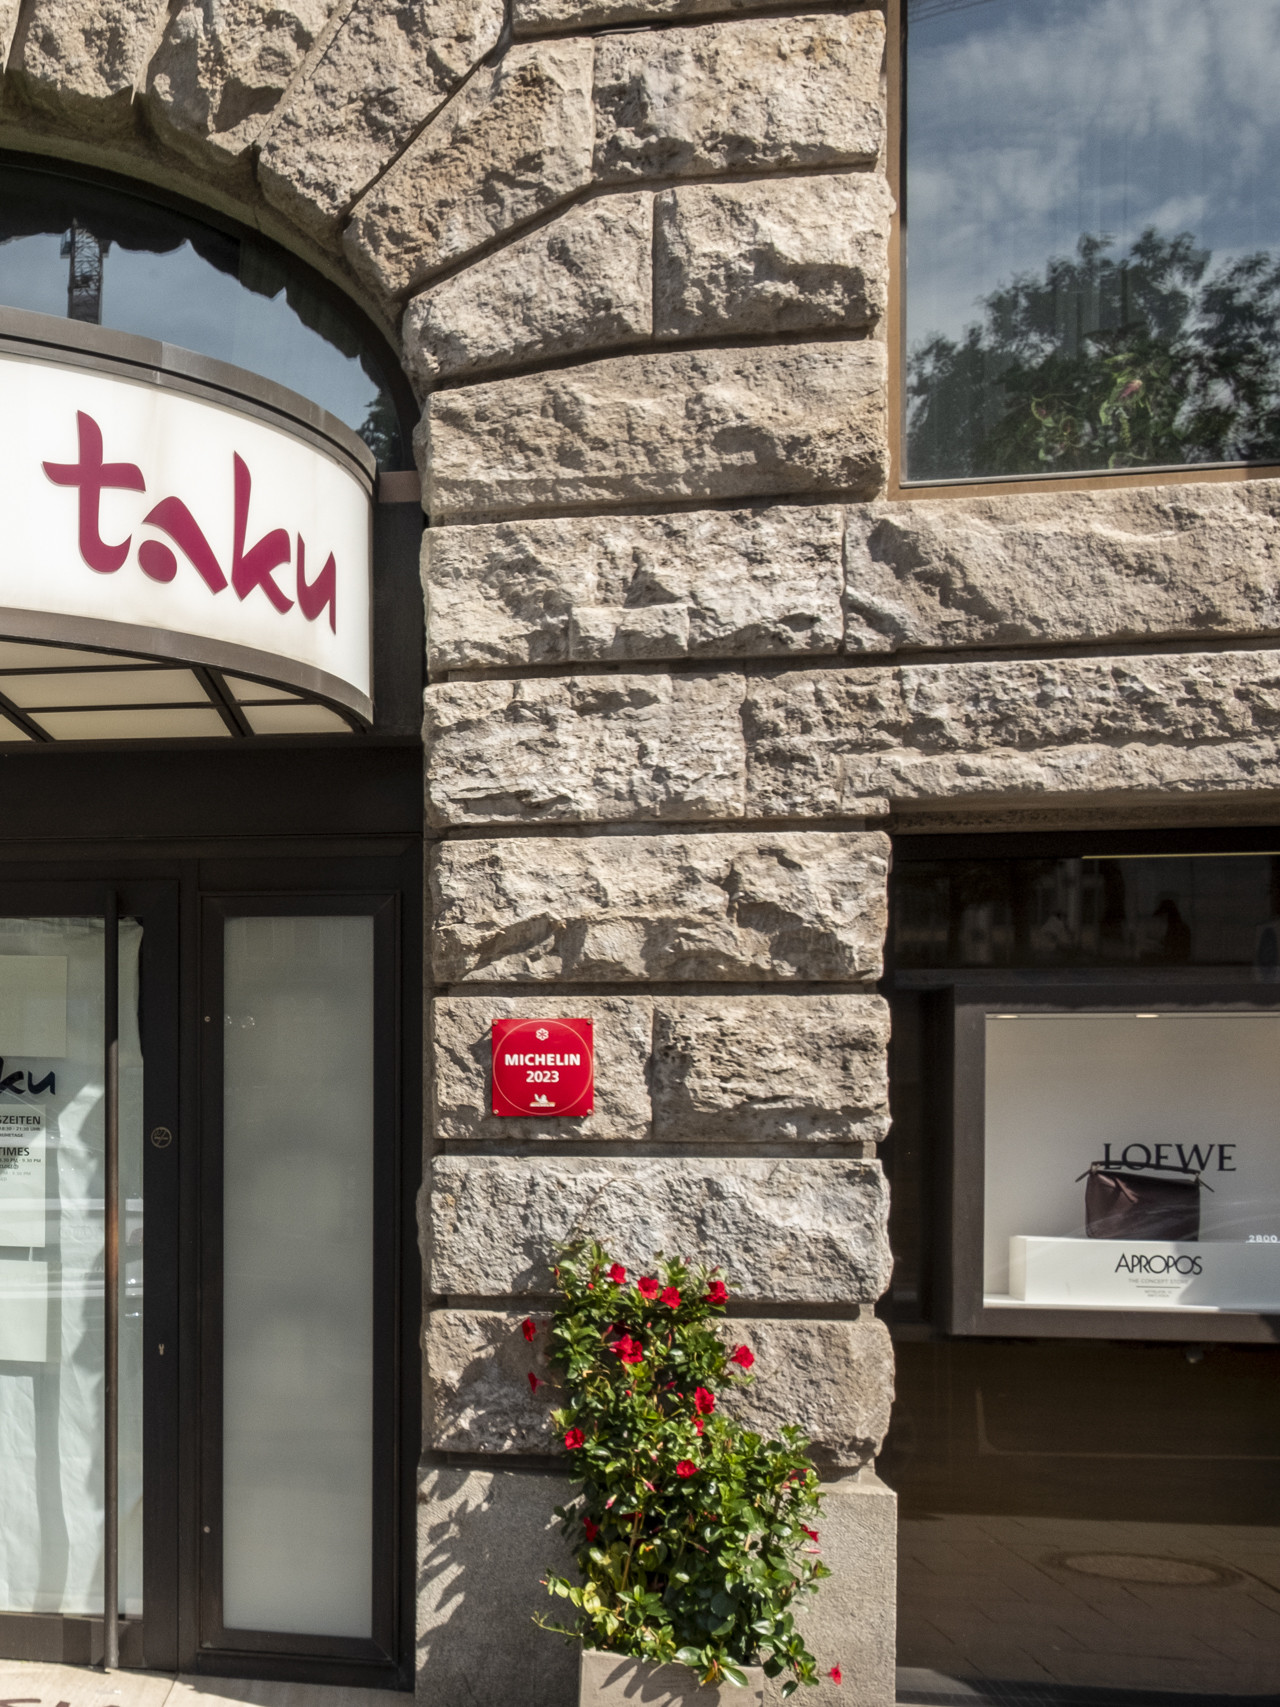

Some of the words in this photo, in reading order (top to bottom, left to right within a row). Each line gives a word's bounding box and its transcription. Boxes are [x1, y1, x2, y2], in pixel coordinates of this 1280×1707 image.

[41, 409, 336, 637] taku
[504, 1053, 581, 1067] MICHELIN
[526, 1070, 560, 1083] 2023
[1103, 1143, 1237, 1172] LOEWE
[1114, 1253, 1203, 1276] APROPOS
